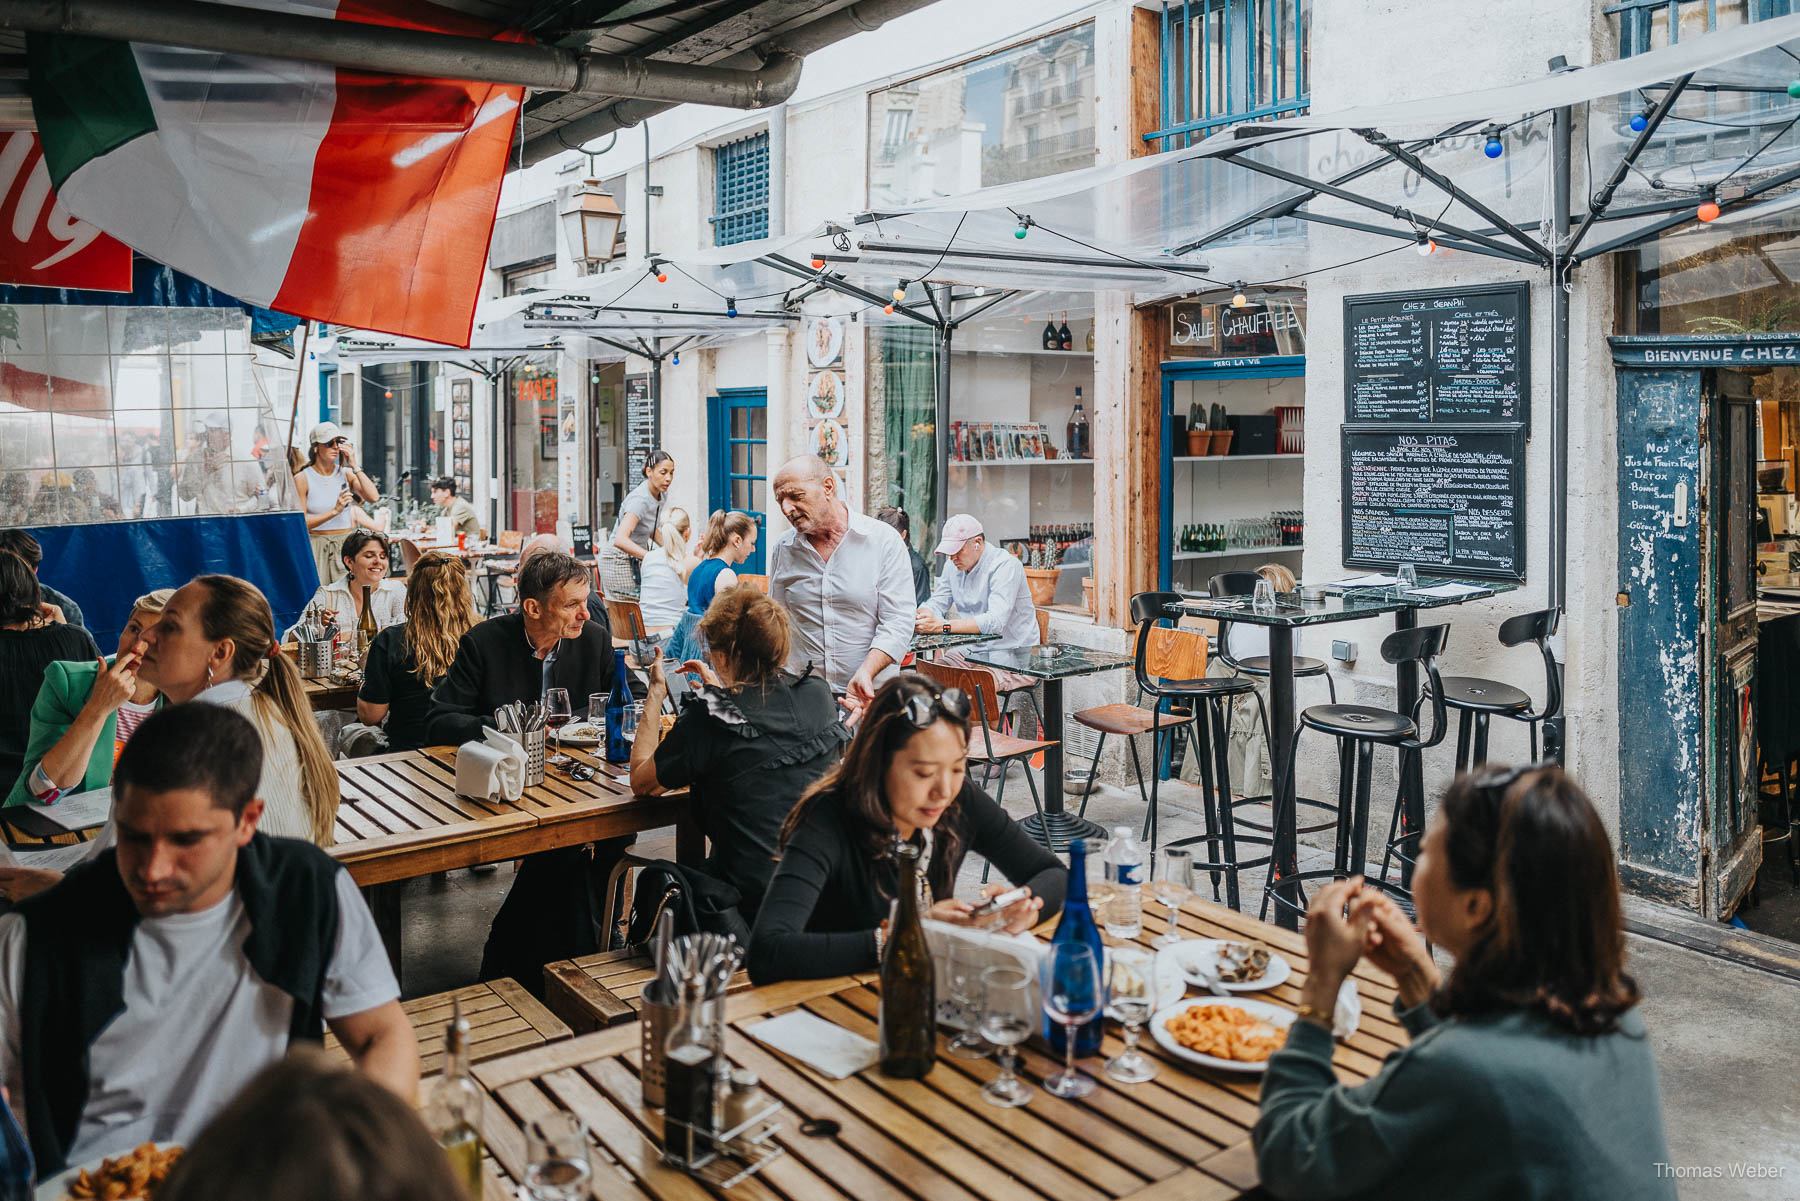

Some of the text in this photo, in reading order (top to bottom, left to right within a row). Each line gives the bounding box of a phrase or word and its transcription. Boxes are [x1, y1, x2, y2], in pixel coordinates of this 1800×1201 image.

[1402, 302, 1426, 311] CHEZ
[1176, 313, 1216, 345] SALLE
[1644, 346, 1797, 362] BIENVENUE CHEZ
[1398, 434, 1458, 446] NOS PITAS
[1646, 442, 1670, 454] Nos
